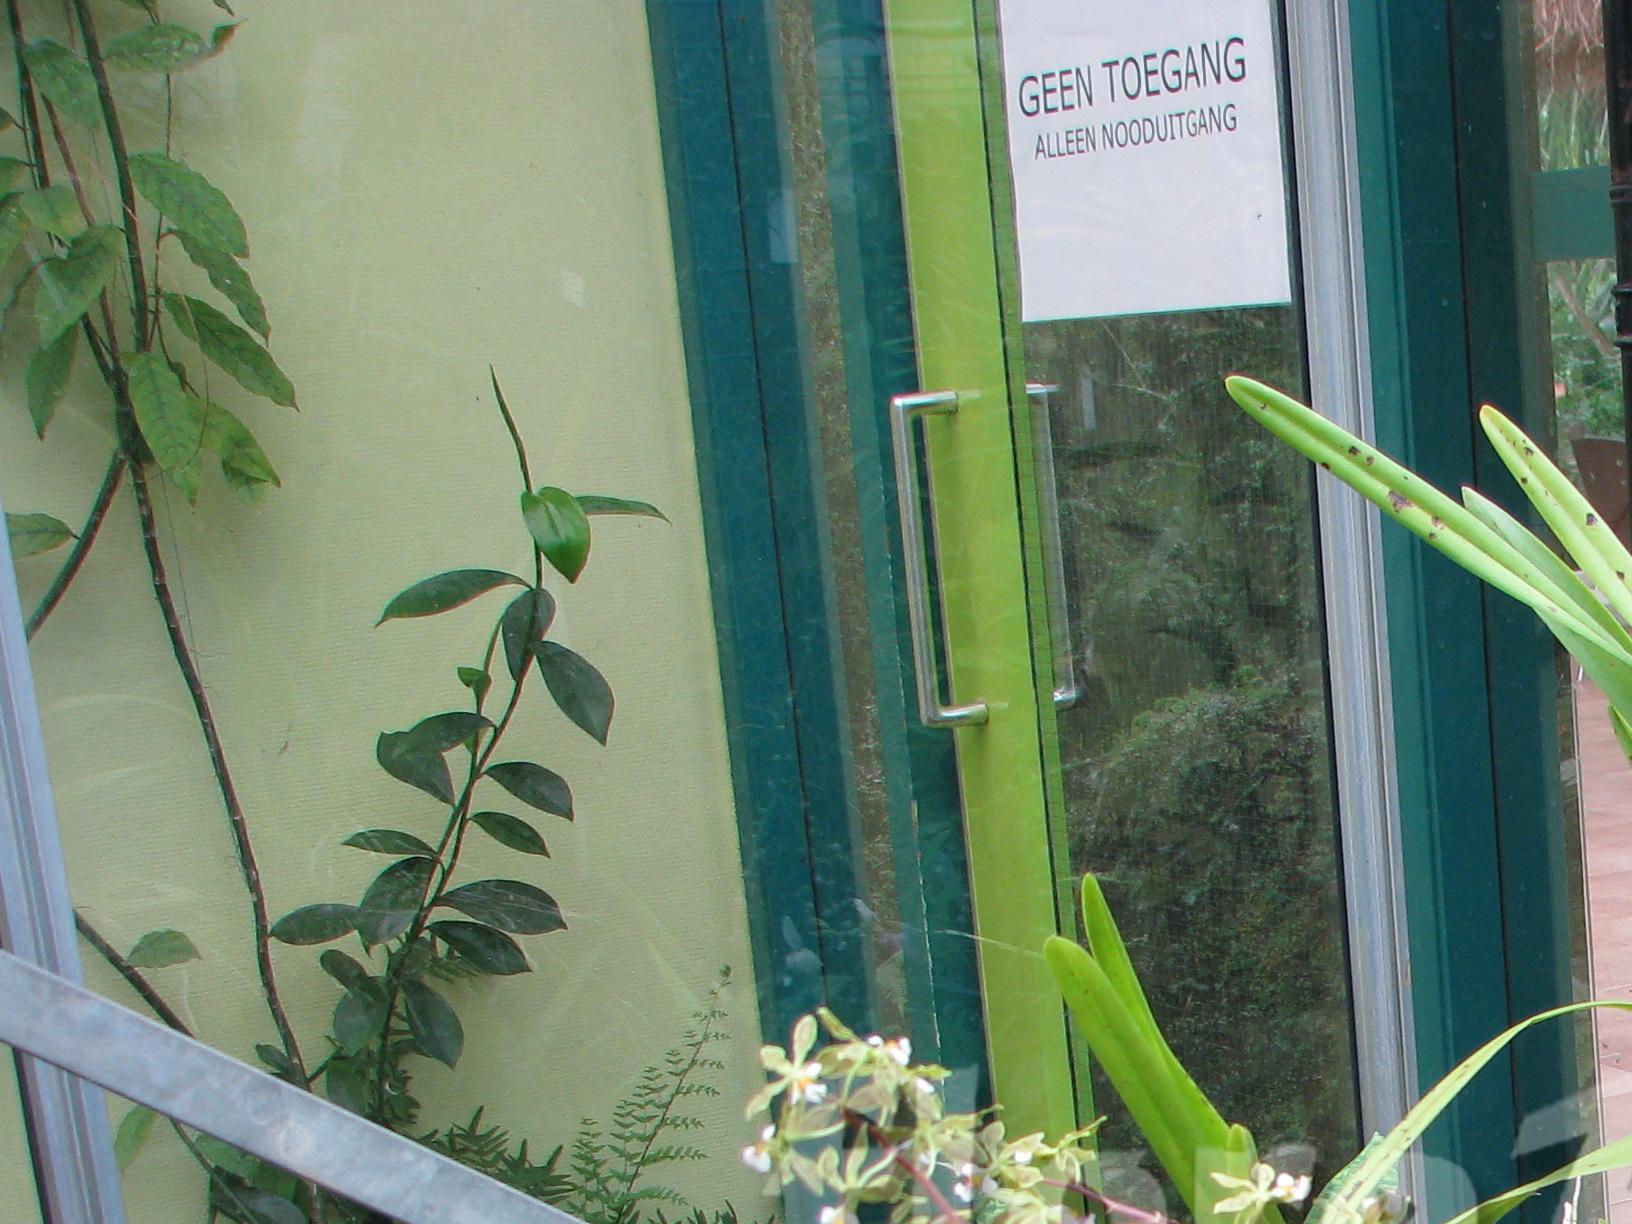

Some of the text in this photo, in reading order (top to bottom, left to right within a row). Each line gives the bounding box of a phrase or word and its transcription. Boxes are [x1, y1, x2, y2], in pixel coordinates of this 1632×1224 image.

[1018, 37, 1246, 117] GEEN TOEGANG
[1034, 103, 1237, 160] ALLEEN NOODUITGANG
